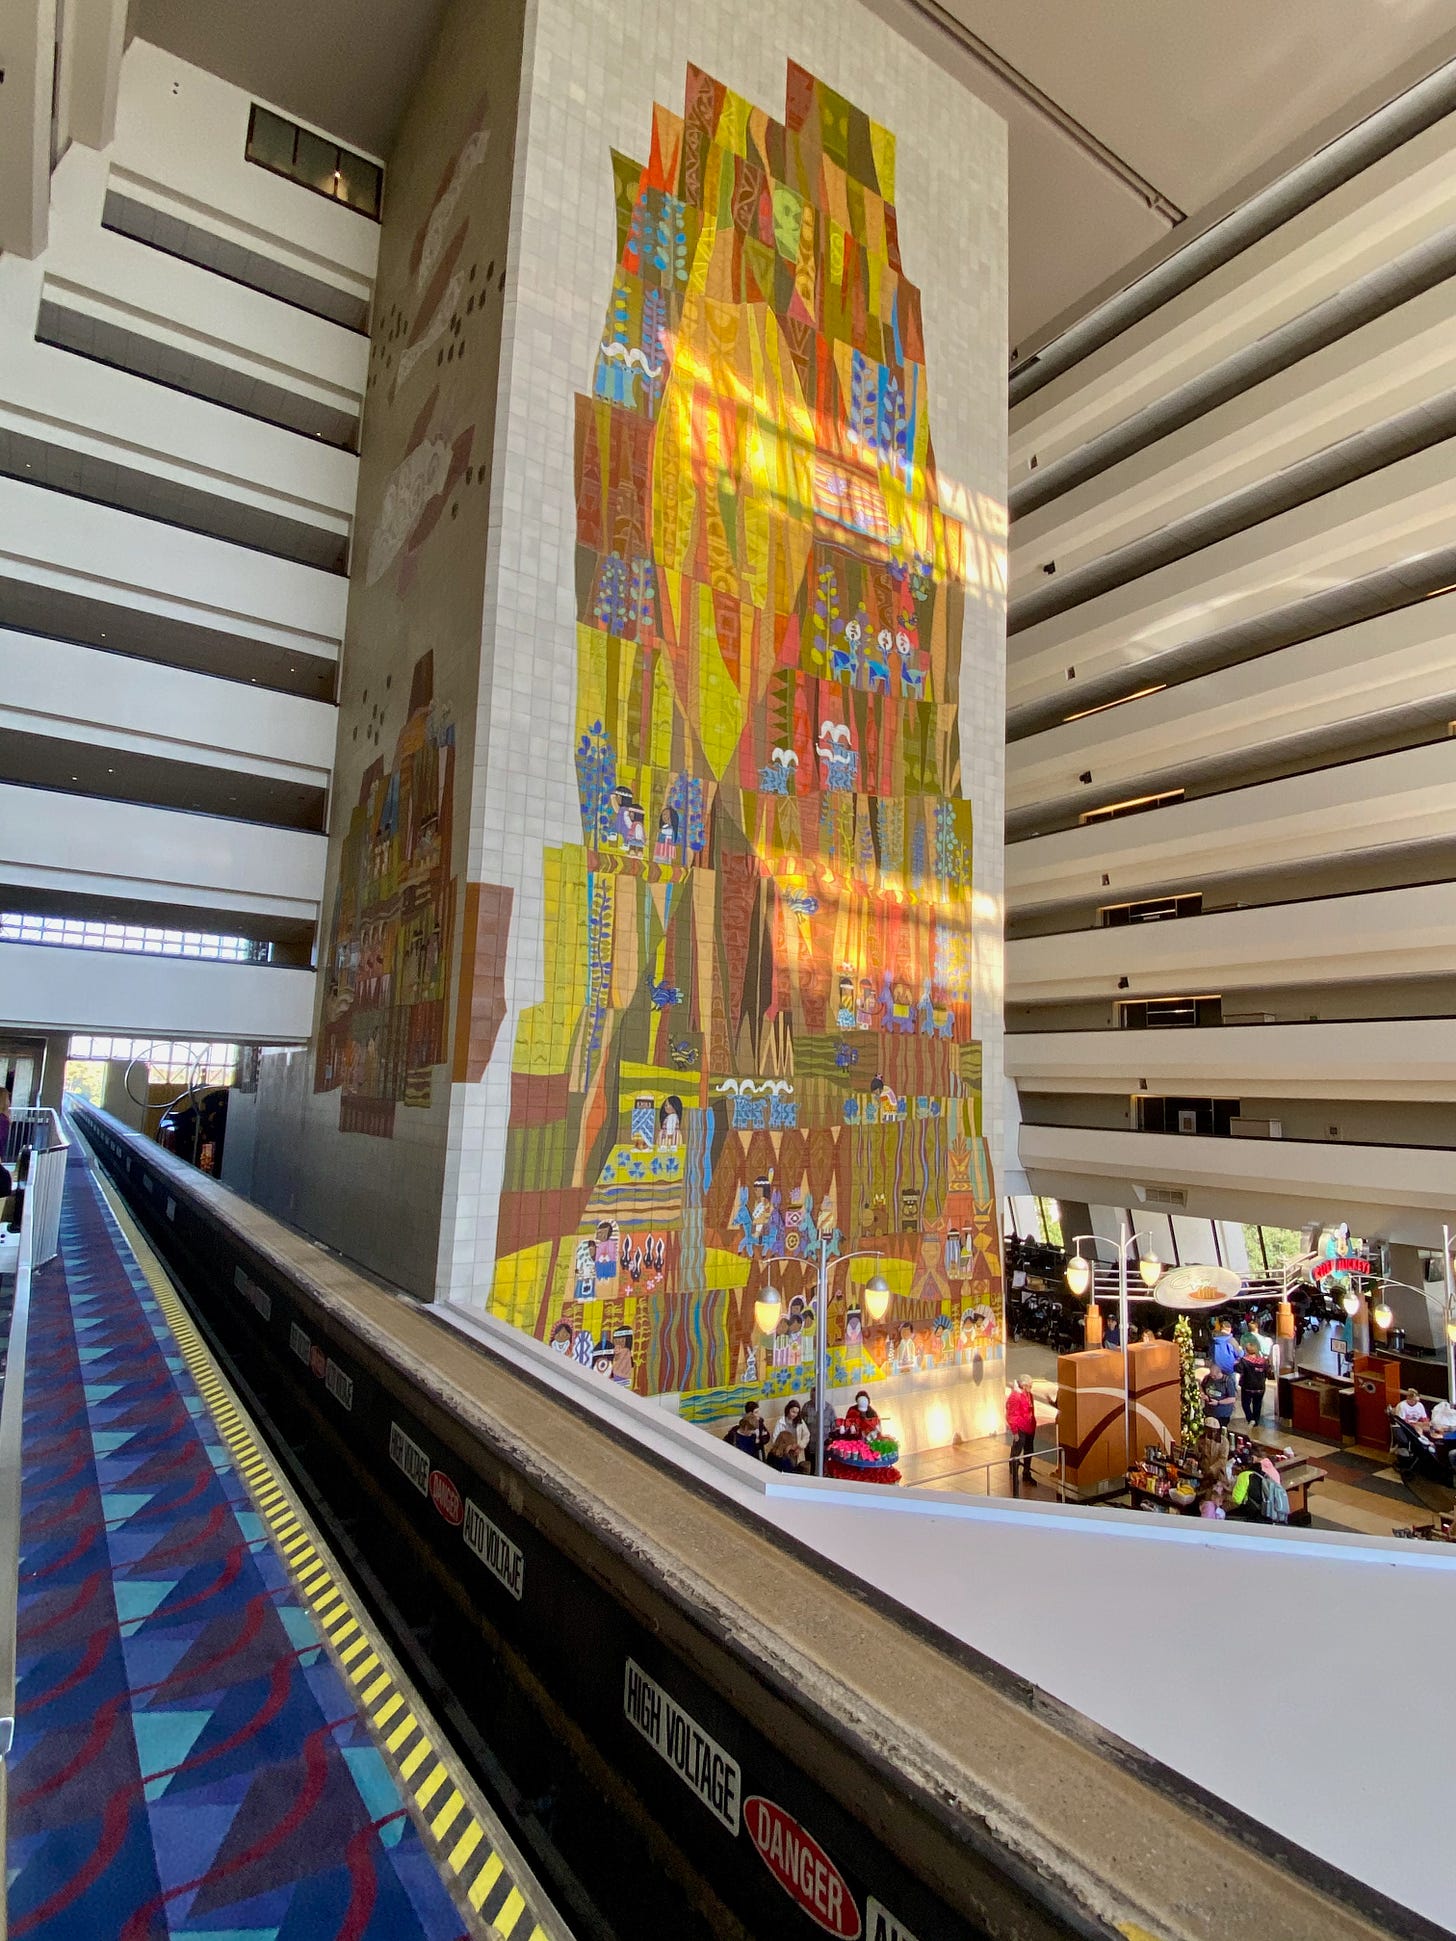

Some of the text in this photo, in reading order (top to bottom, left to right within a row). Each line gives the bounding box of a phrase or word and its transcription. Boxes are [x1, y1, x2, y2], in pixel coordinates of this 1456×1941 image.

[464, 1504, 522, 1595] ALTO VOLTAJE
[627, 1666, 736, 1826] HIGH VOLTAGE
[757, 1802, 842, 1932] DANGER
